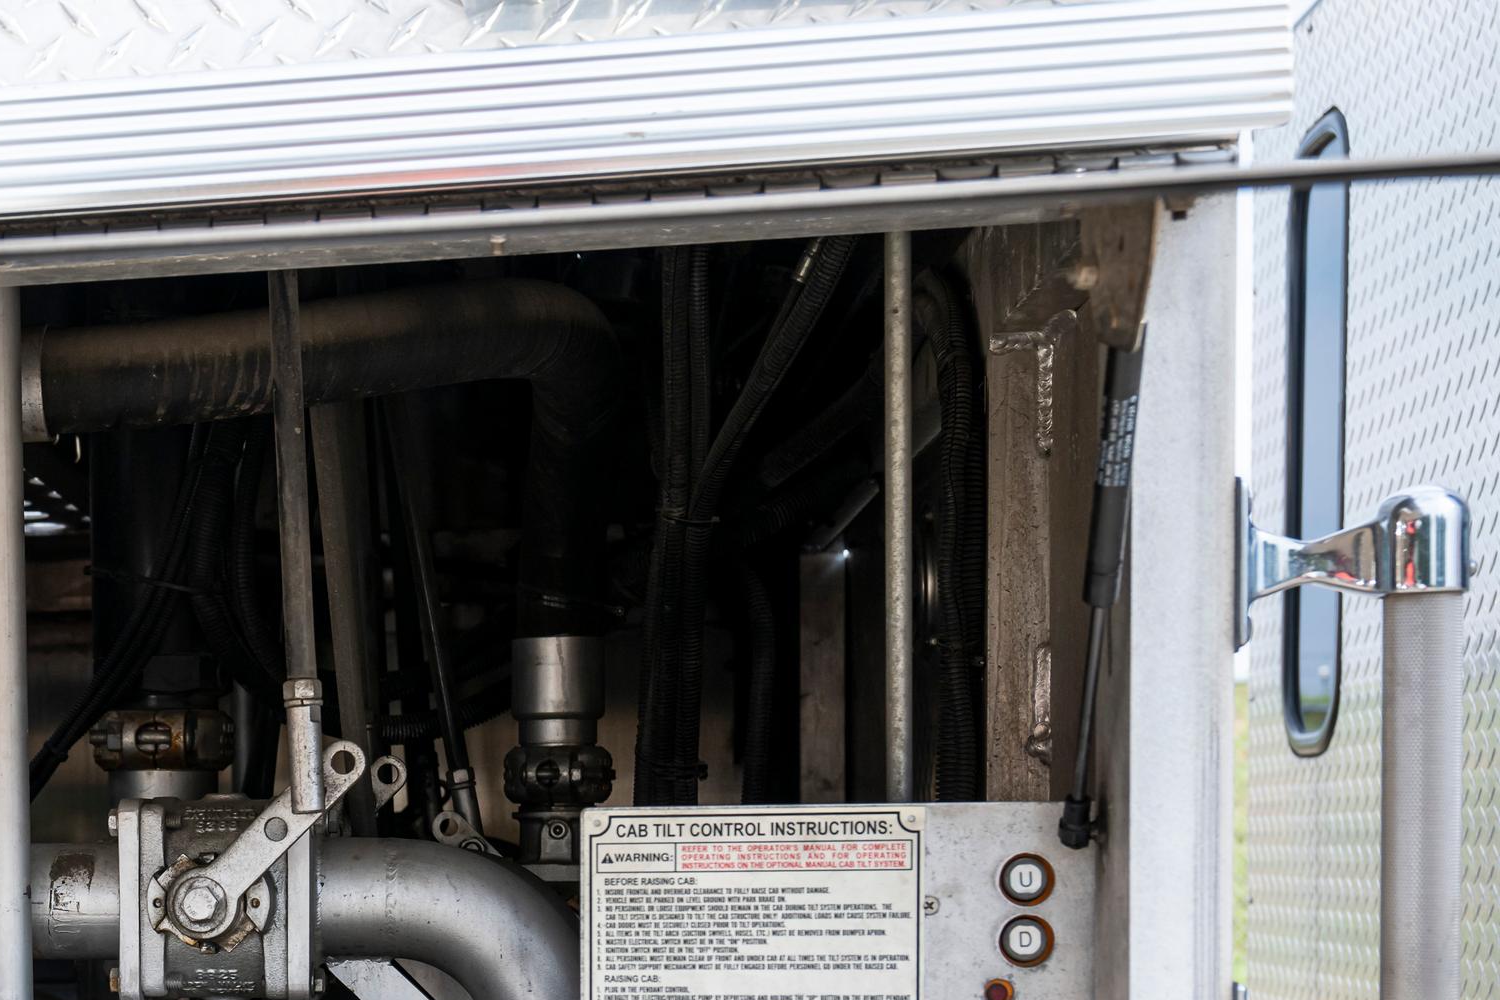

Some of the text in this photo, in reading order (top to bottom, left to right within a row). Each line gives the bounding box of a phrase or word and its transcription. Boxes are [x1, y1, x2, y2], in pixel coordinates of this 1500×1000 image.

[616, 820, 892, 838] CAB TILT CONTROL INSTRUCTIONS:
[614, 852, 675, 863] WARNING:
[604, 877, 697, 886] BEFORE RAISING CAB:
[1019, 871, 1033, 887] U
[1019, 931, 1032, 947] D
[604, 975, 660, 983] RAISING CAB:
